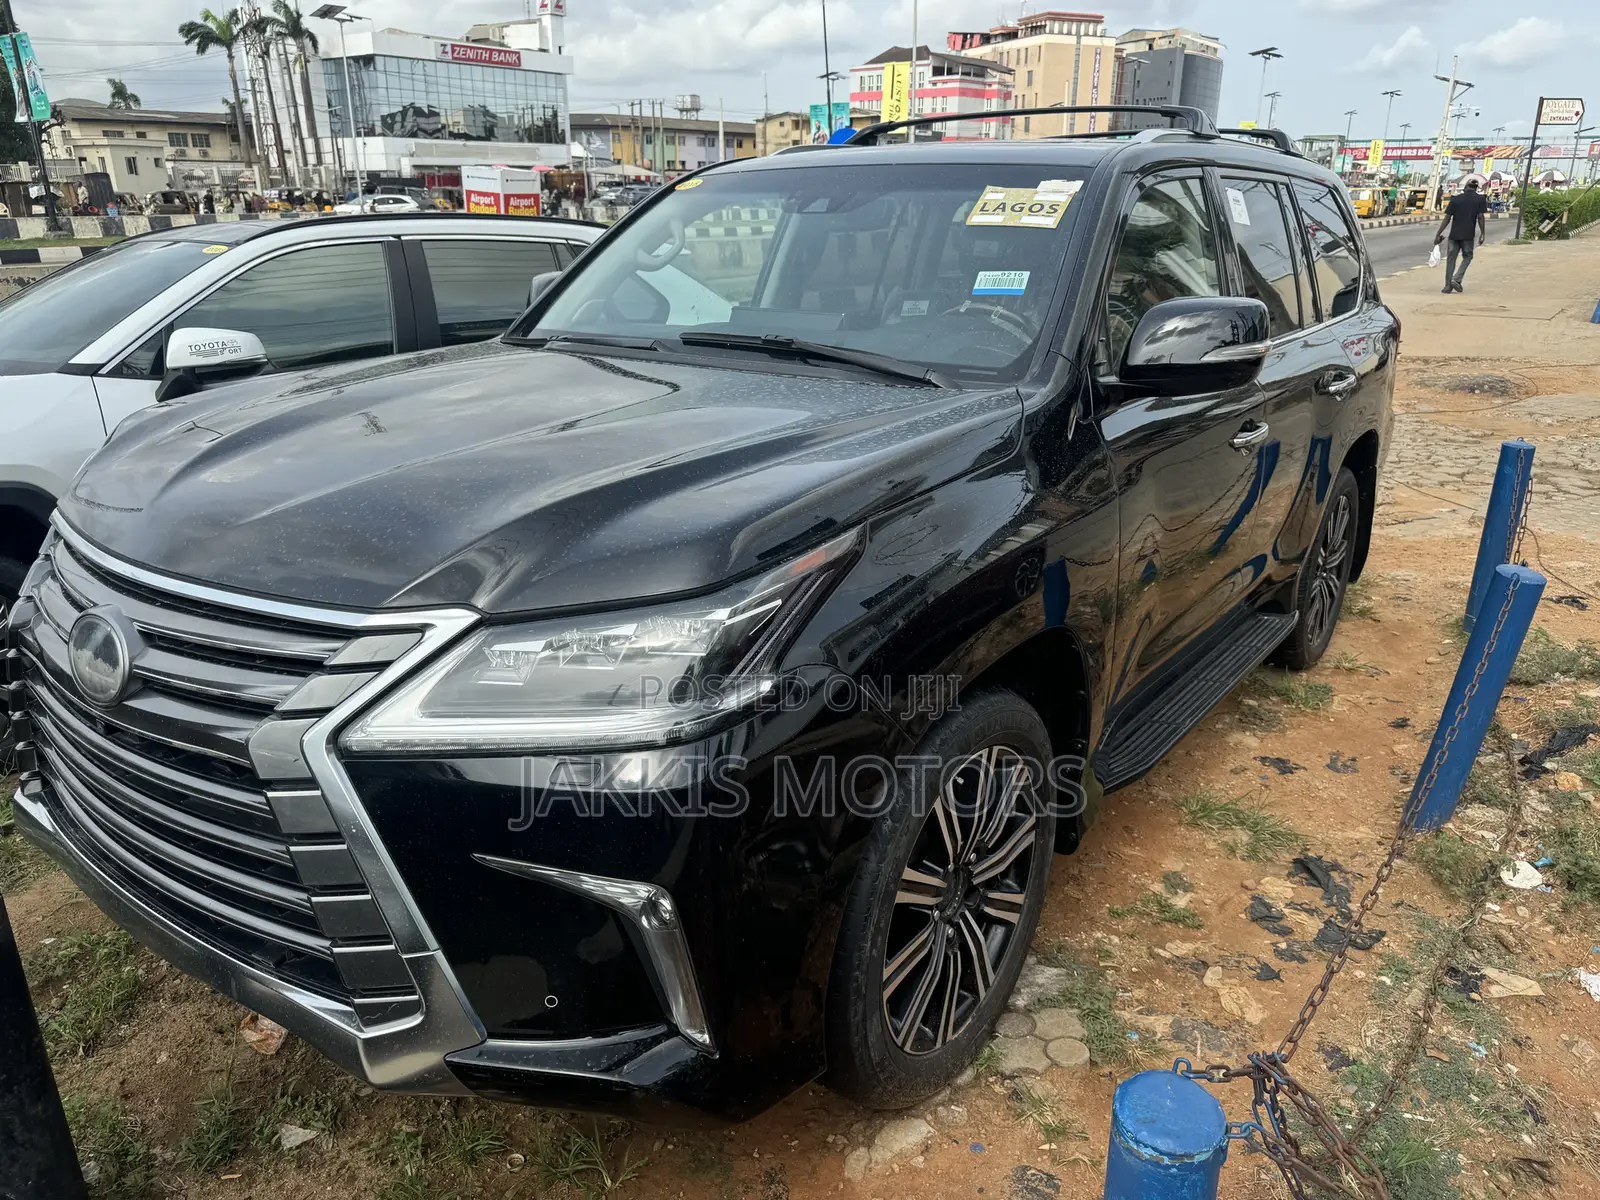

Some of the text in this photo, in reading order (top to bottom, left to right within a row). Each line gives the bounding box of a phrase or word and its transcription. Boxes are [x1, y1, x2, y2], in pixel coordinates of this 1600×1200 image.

[453, 46, 520, 64] ZENITH BANK
[894, 73, 903, 122] AUSTON
[1544, 100, 1577, 110] JOYGATE
[1386, 148, 1418, 157] SAVERS
[1418, 148, 1432, 157] DEA
[470, 193, 495, 205] Airport
[509, 196, 535, 208] Airport
[979, 202, 1060, 214] LAGOS
[188, 340, 228, 352] TOYOTA
